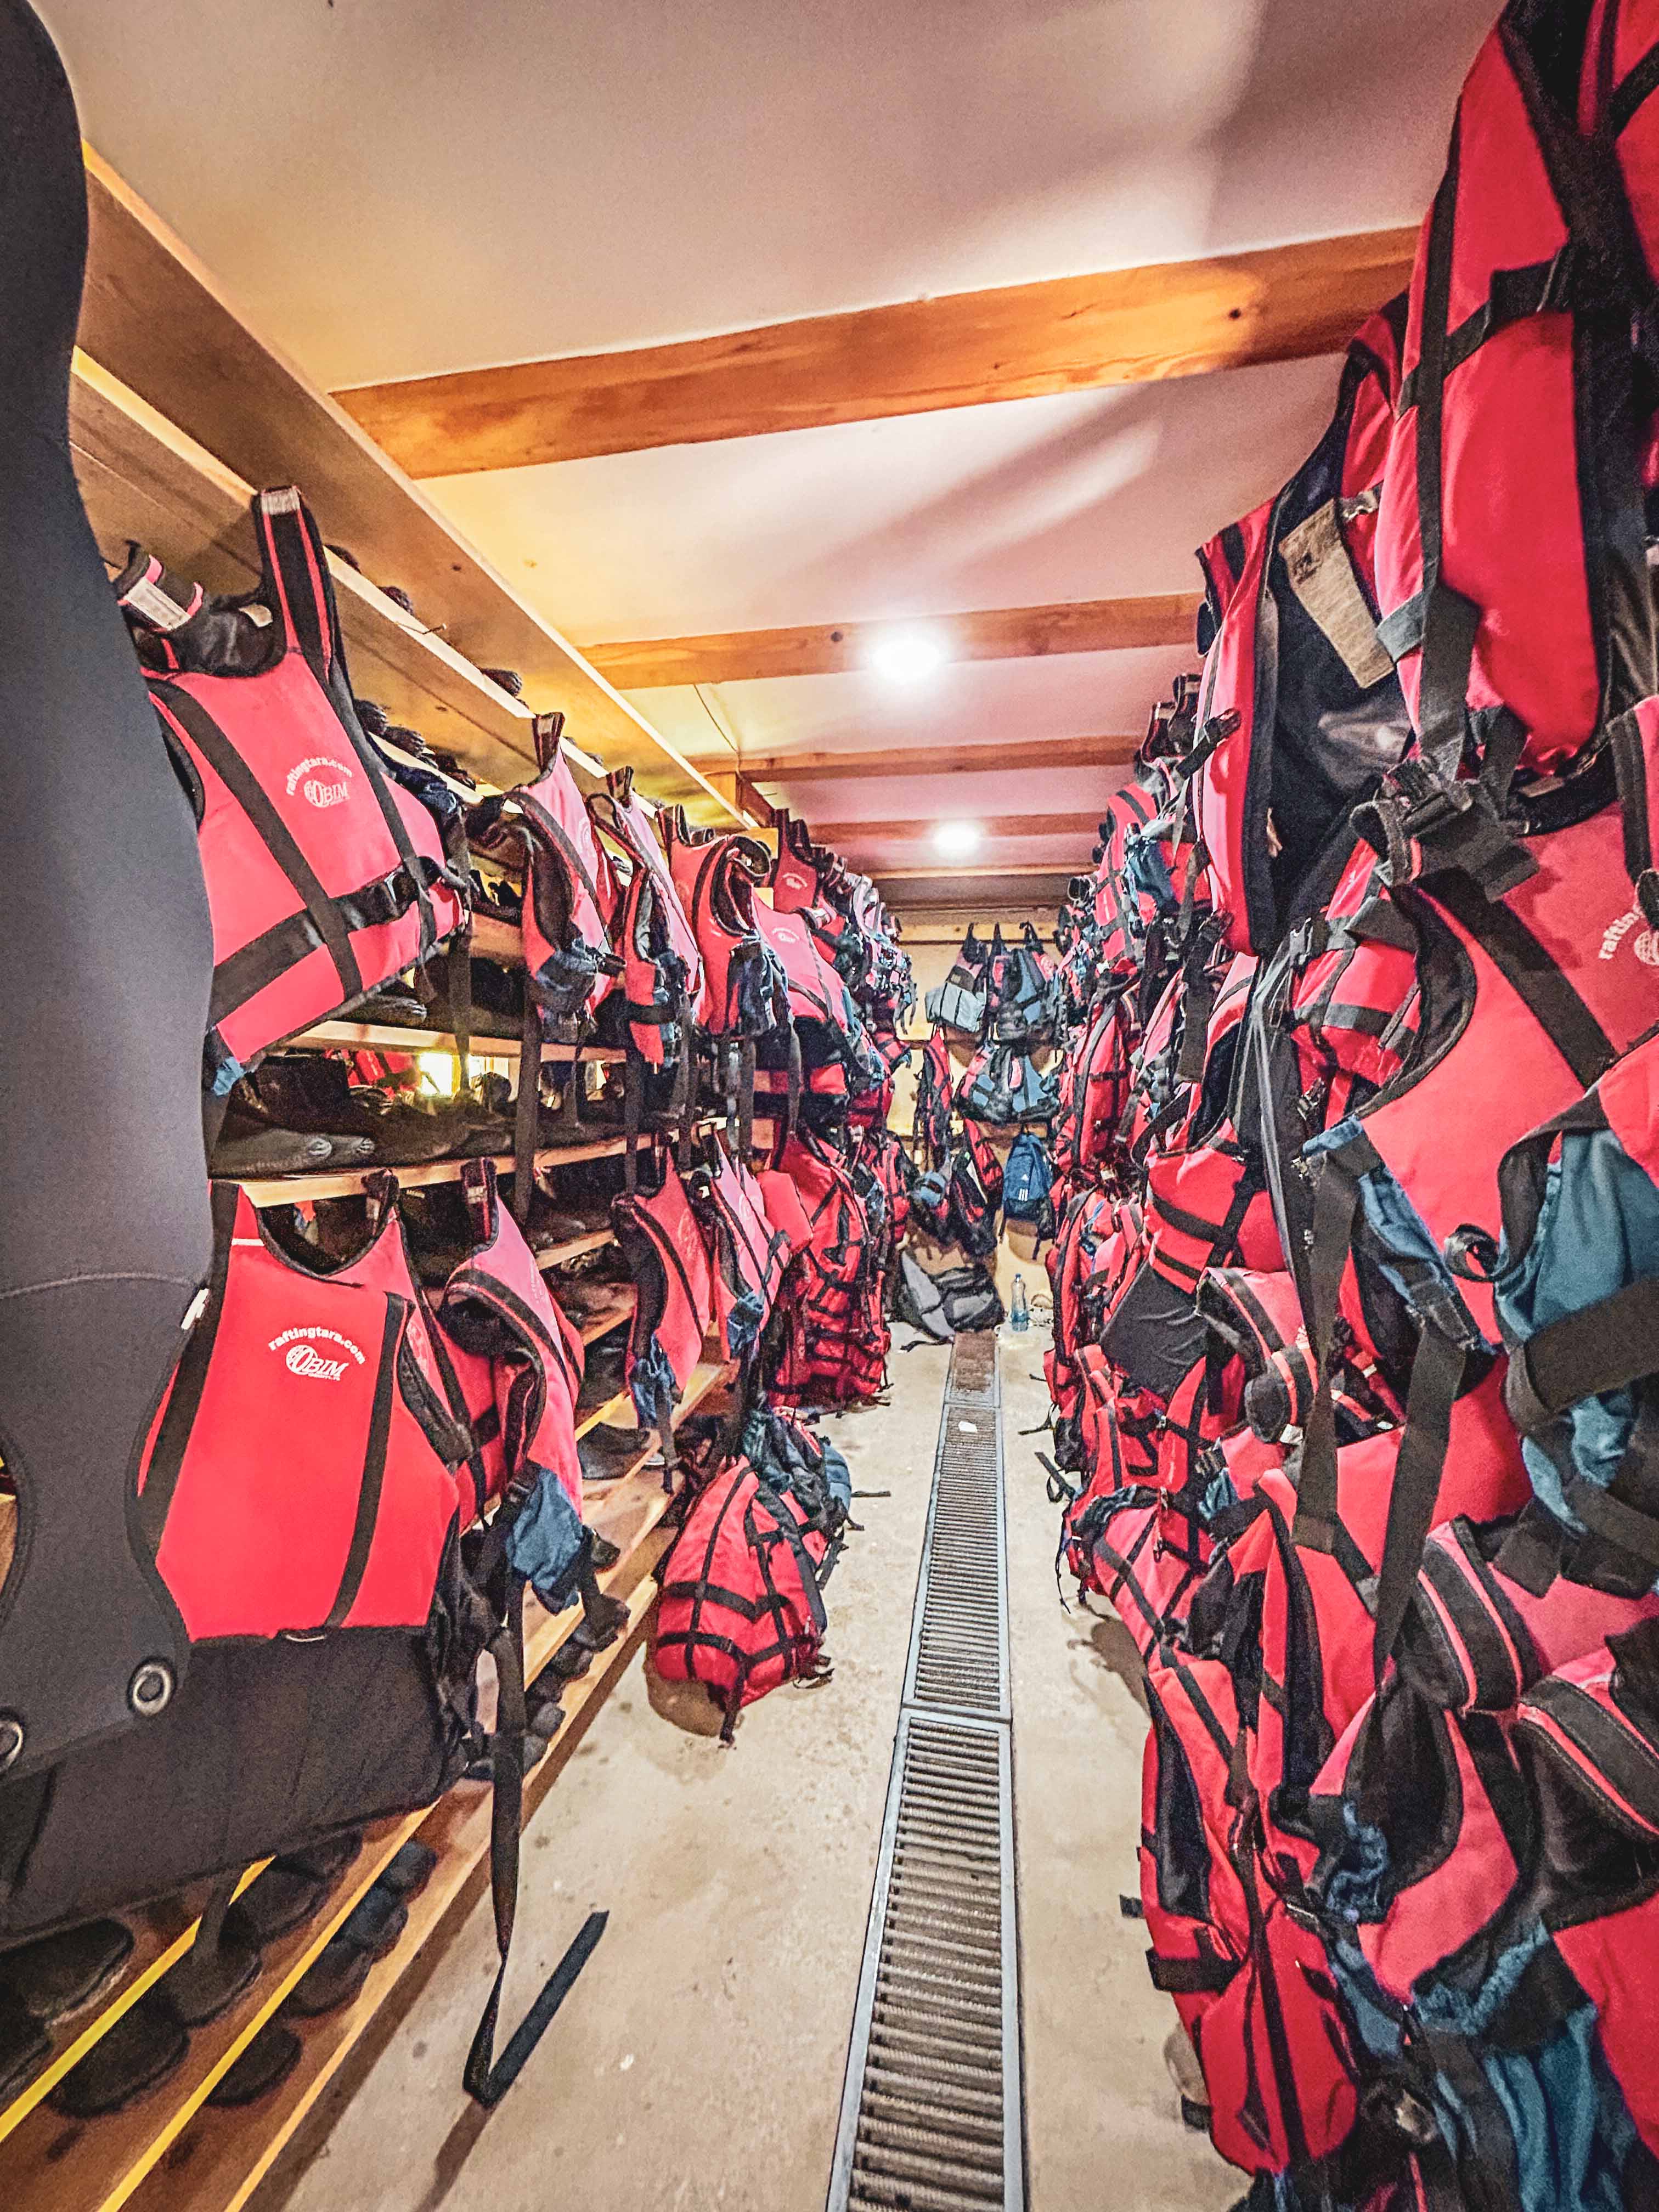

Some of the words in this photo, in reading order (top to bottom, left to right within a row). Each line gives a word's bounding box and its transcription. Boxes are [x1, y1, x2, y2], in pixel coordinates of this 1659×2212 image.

[286, 757, 352, 795] raftingtara.com
[268, 1327, 365, 1365] raftingtara.com
[287, 1345, 349, 1376] OBIM
